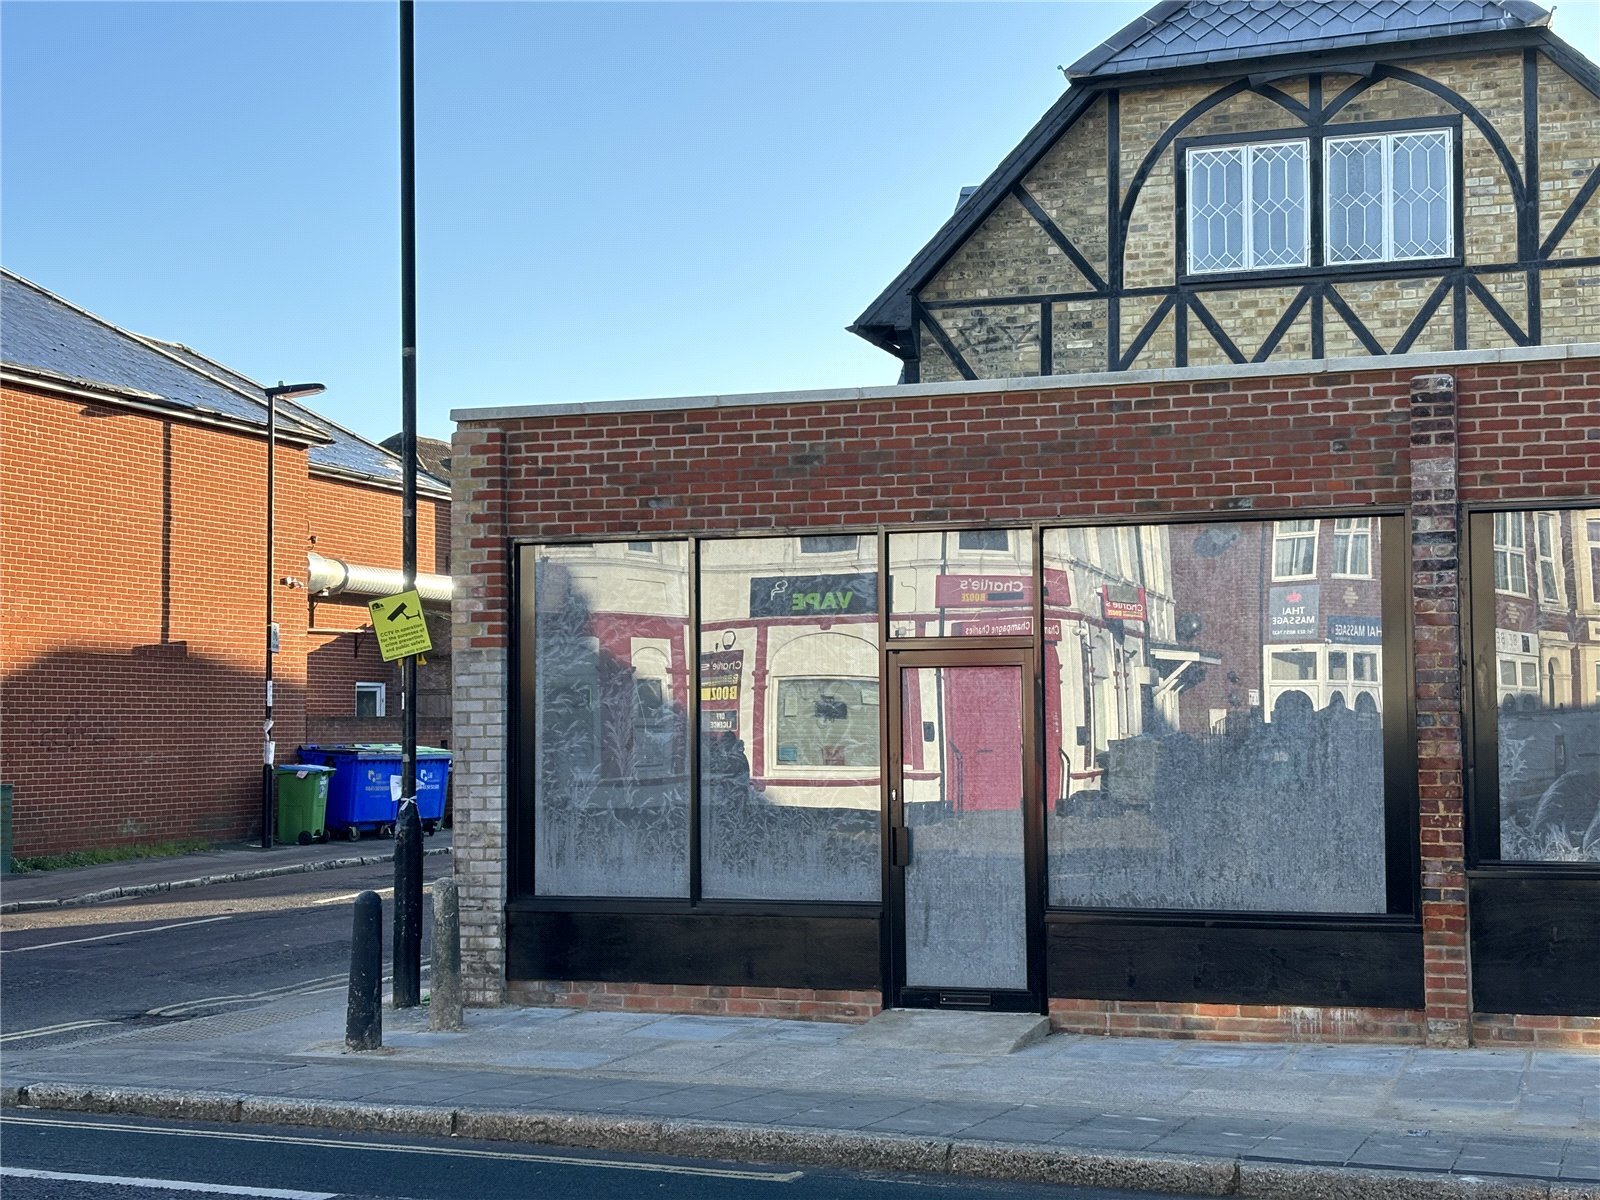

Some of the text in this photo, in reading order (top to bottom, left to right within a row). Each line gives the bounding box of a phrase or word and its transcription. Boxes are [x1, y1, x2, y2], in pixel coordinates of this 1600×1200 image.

[380, 630, 394, 638] CCTV
[400, 623, 423, 632] operation
[397, 630, 419, 639] purposes
[385, 634, 423, 648] crime prevention
[396, 643, 410, 651] public
[411, 639, 426, 647] safety
